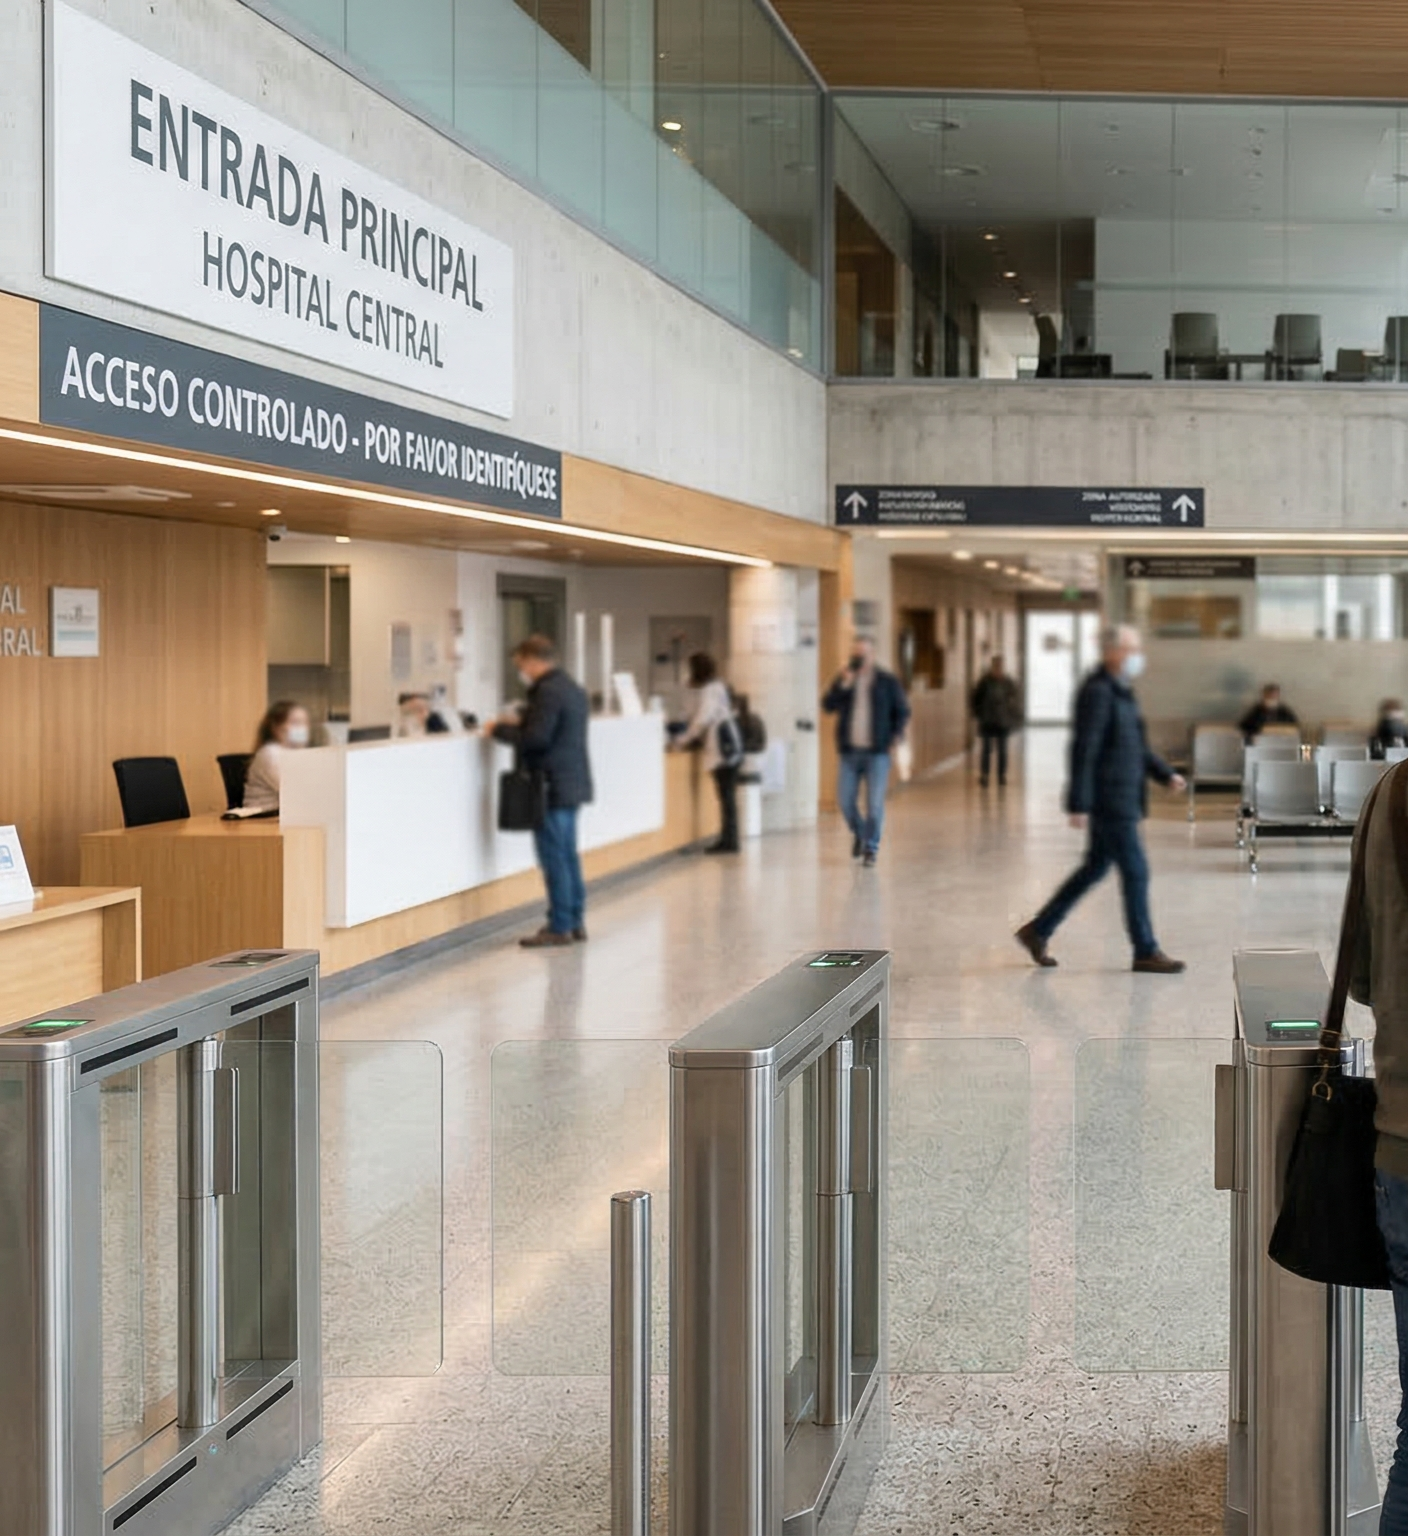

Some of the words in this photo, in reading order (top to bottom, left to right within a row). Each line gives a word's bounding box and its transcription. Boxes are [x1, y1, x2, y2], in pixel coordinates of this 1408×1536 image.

[130, 78, 330, 245] ENTRADA
[341, 187, 484, 312] PRINCIPAL
[203, 230, 338, 332] HOSPITAL
[345, 289, 444, 369] CENTRAL
[60, 345, 179, 418] ACCESO
[187, 377, 348, 454] CONTROLADO
[351, 437, 360, 447] -
[364, 421, 402, 467] POR
[405, 431, 459, 479] FAVOR
[461, 445, 557, 500] IDENTIFÍQUESE
[0, 626, 42, 656] RAL
